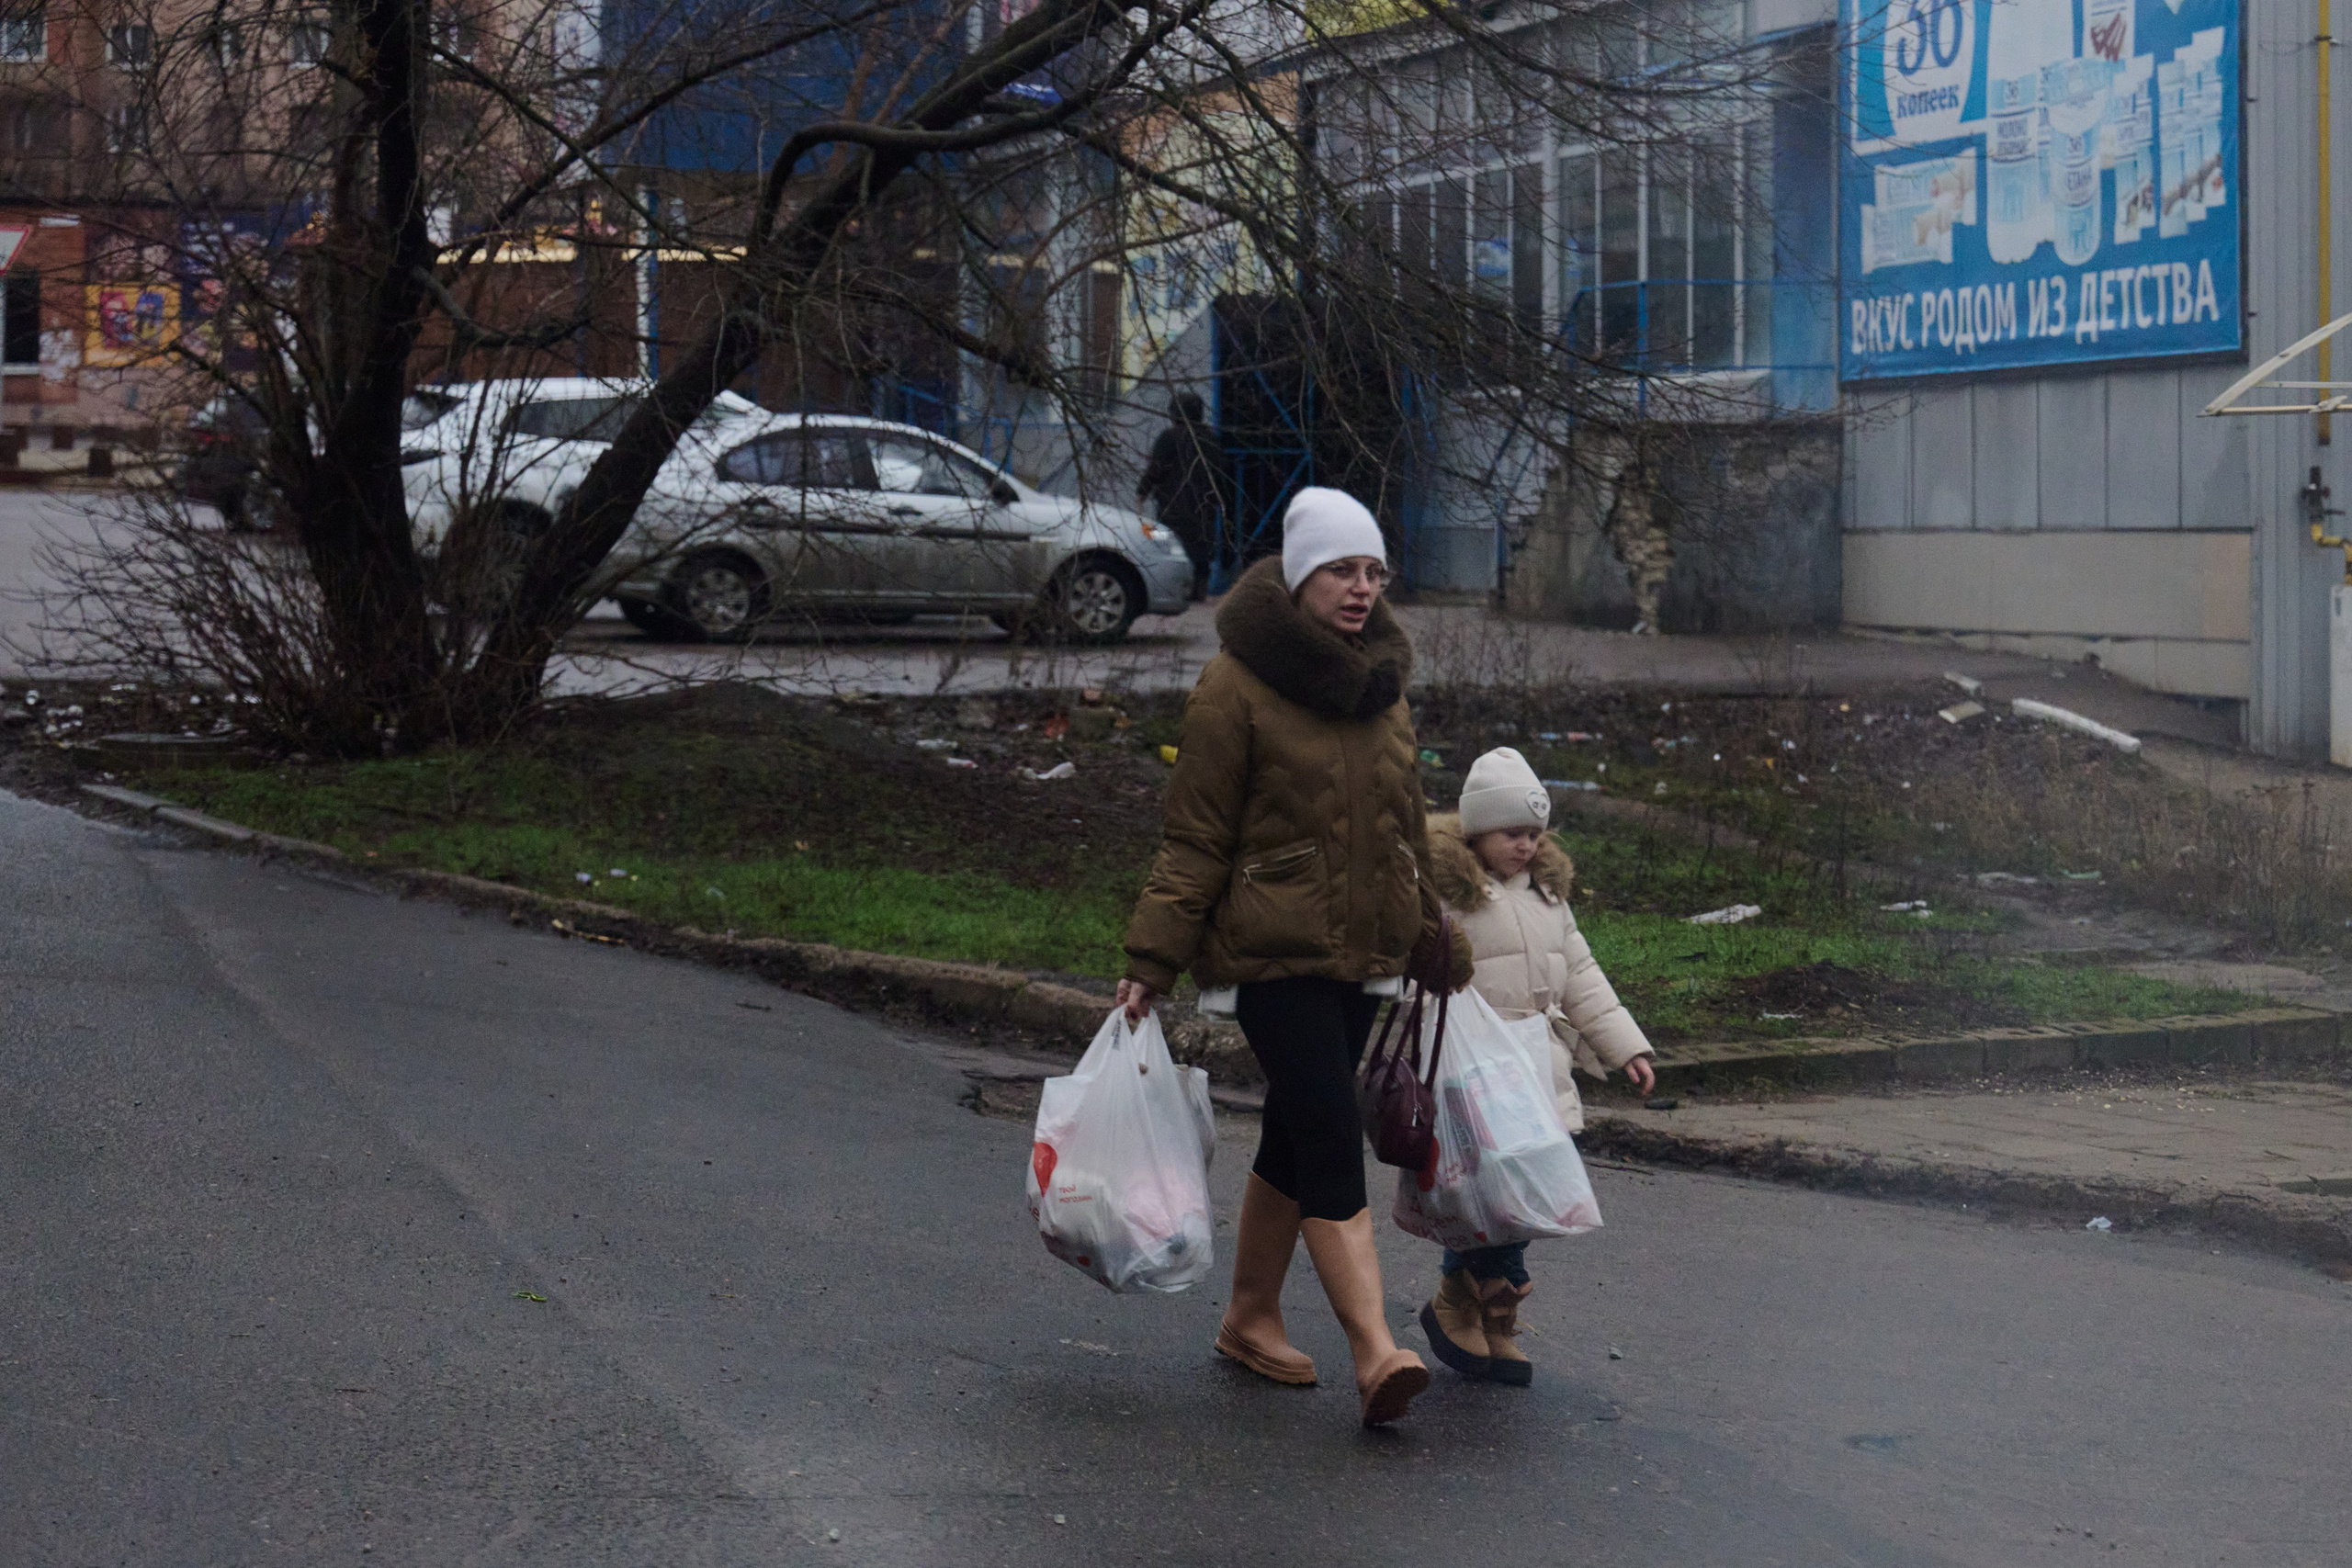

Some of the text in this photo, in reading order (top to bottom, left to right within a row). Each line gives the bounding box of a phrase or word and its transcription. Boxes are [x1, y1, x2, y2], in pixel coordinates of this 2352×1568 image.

[1851, 258, 2220, 355] ВКУС РОДОМ ИЗ ДЕТСТВА
